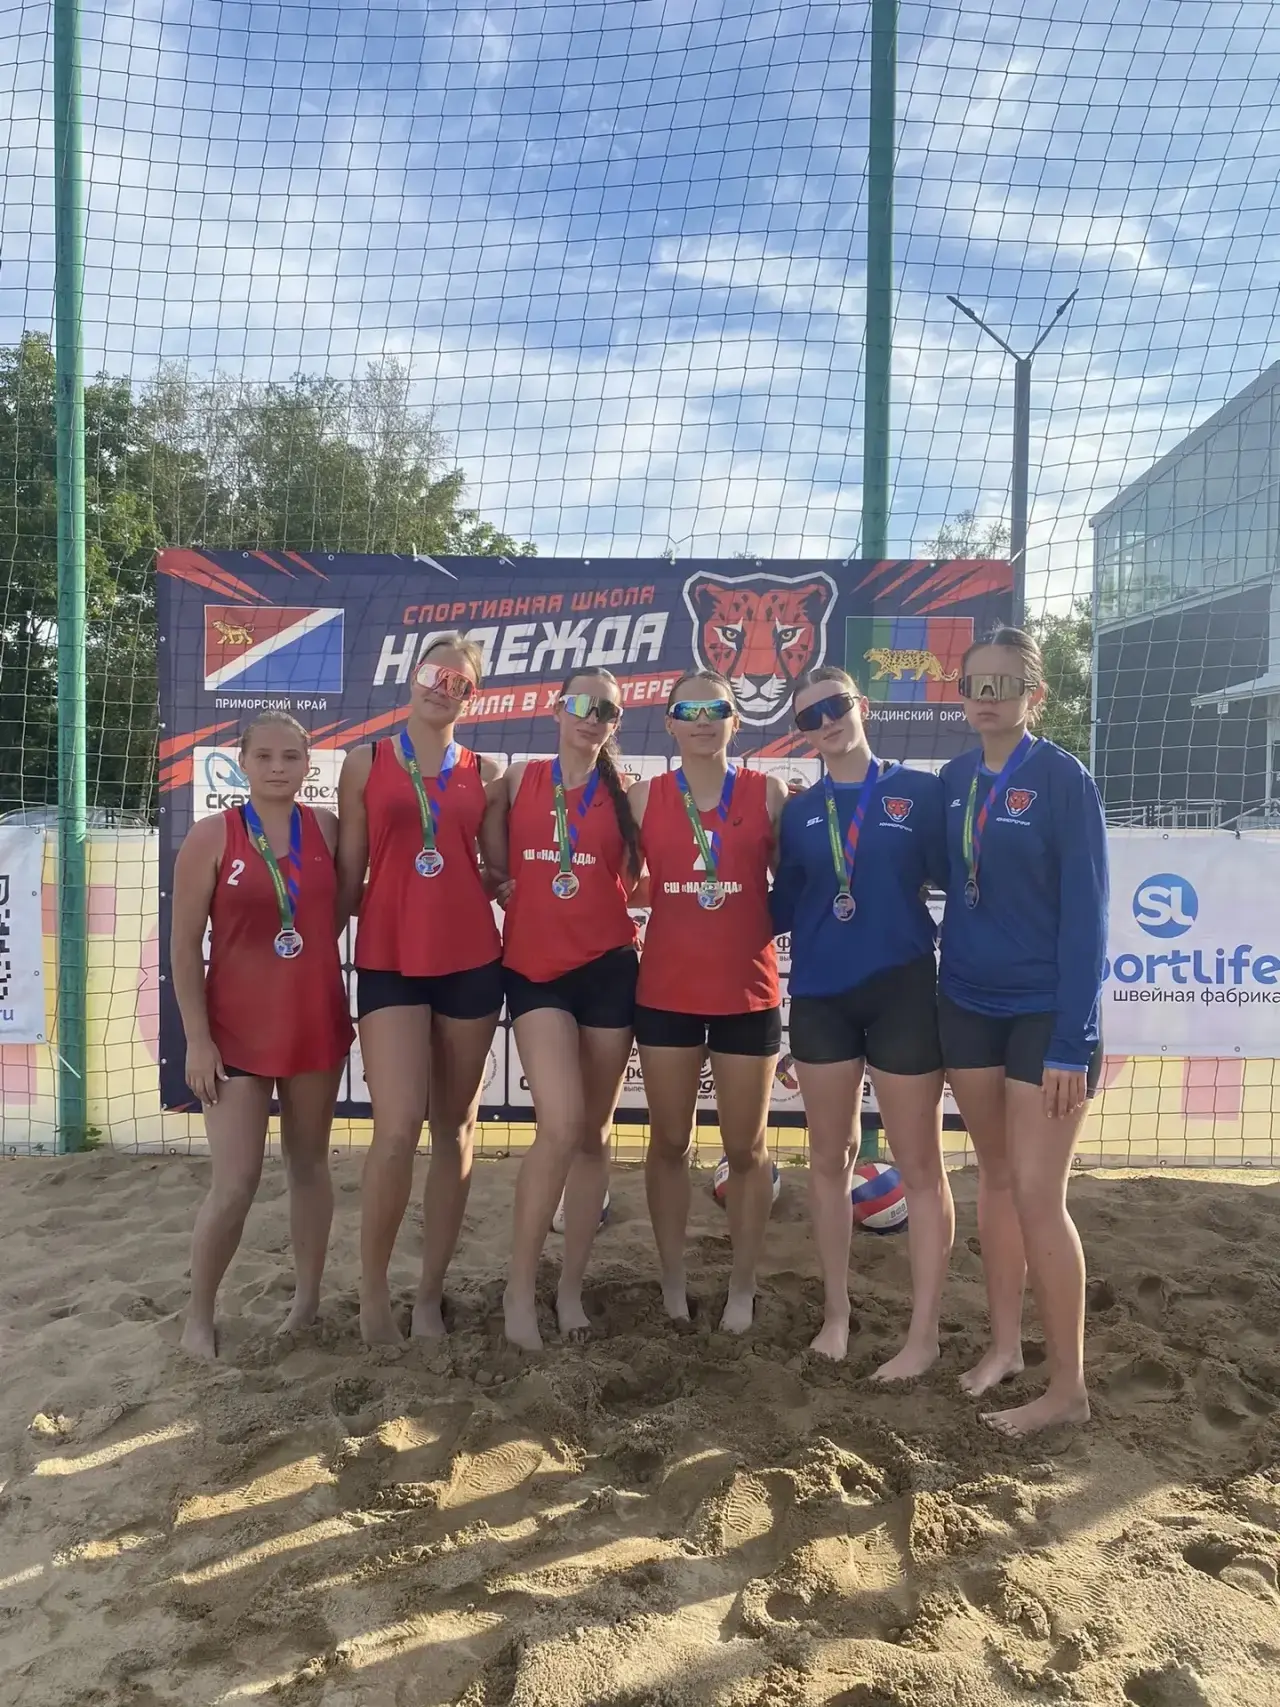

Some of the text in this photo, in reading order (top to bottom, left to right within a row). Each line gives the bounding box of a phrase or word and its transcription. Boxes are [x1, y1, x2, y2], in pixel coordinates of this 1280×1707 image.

[402, 585, 655, 625] СПОРТИВНАЯ ШКОЛА
[215, 697, 327, 710] ПРИМОРСКИЙ КРАЙ
[522, 692, 537, 711] В
[940, 711, 967, 721] ОКРУ
[227, 859, 245, 886] 2
[664, 882, 680, 893] СШ
[1113, 986, 1280, 1007] швейная фабрика
